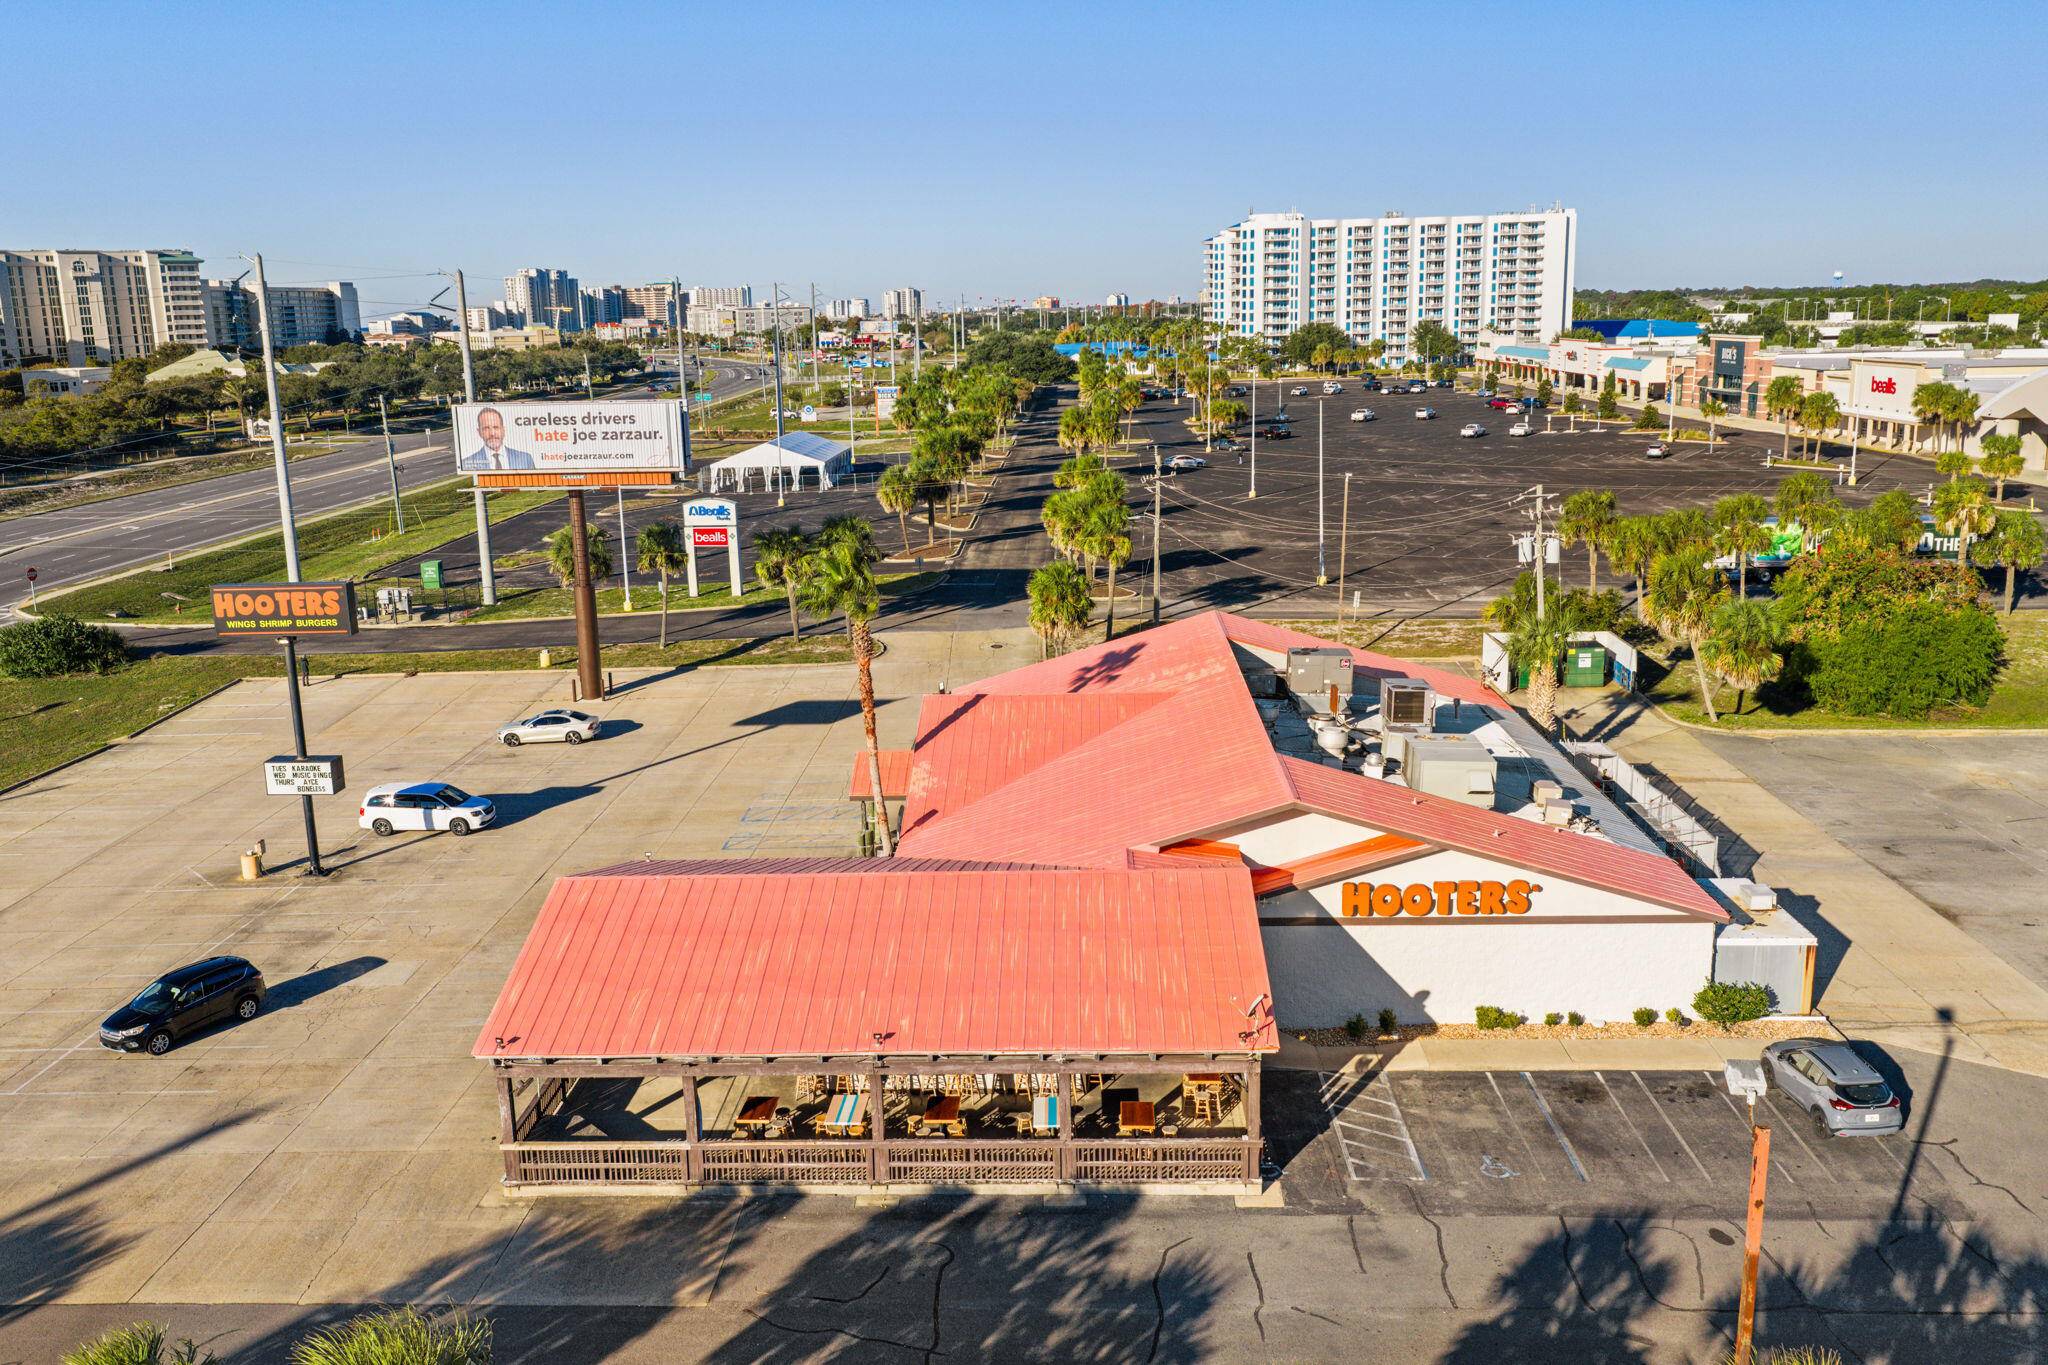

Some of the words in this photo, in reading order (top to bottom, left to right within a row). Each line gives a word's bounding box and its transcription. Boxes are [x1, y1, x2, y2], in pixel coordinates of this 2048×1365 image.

[1871, 376, 1896, 394] bealls
[514, 412, 577, 426] careless
[581, 411, 636, 425] drivers
[534, 428, 568, 442] hate
[572, 428, 597, 444] joe
[601, 428, 663, 441] zarzaur.
[541, 452, 634, 462] ihatejoezarzaur.com
[695, 532, 726, 542] bealls
[213, 590, 341, 618] HOOTERS
[227, 620, 256, 628] WINGS
[260, 619, 293, 628] SHRIMP
[296, 618, 338, 627] BURGERS
[1341, 879, 1533, 917] HOOTERS
